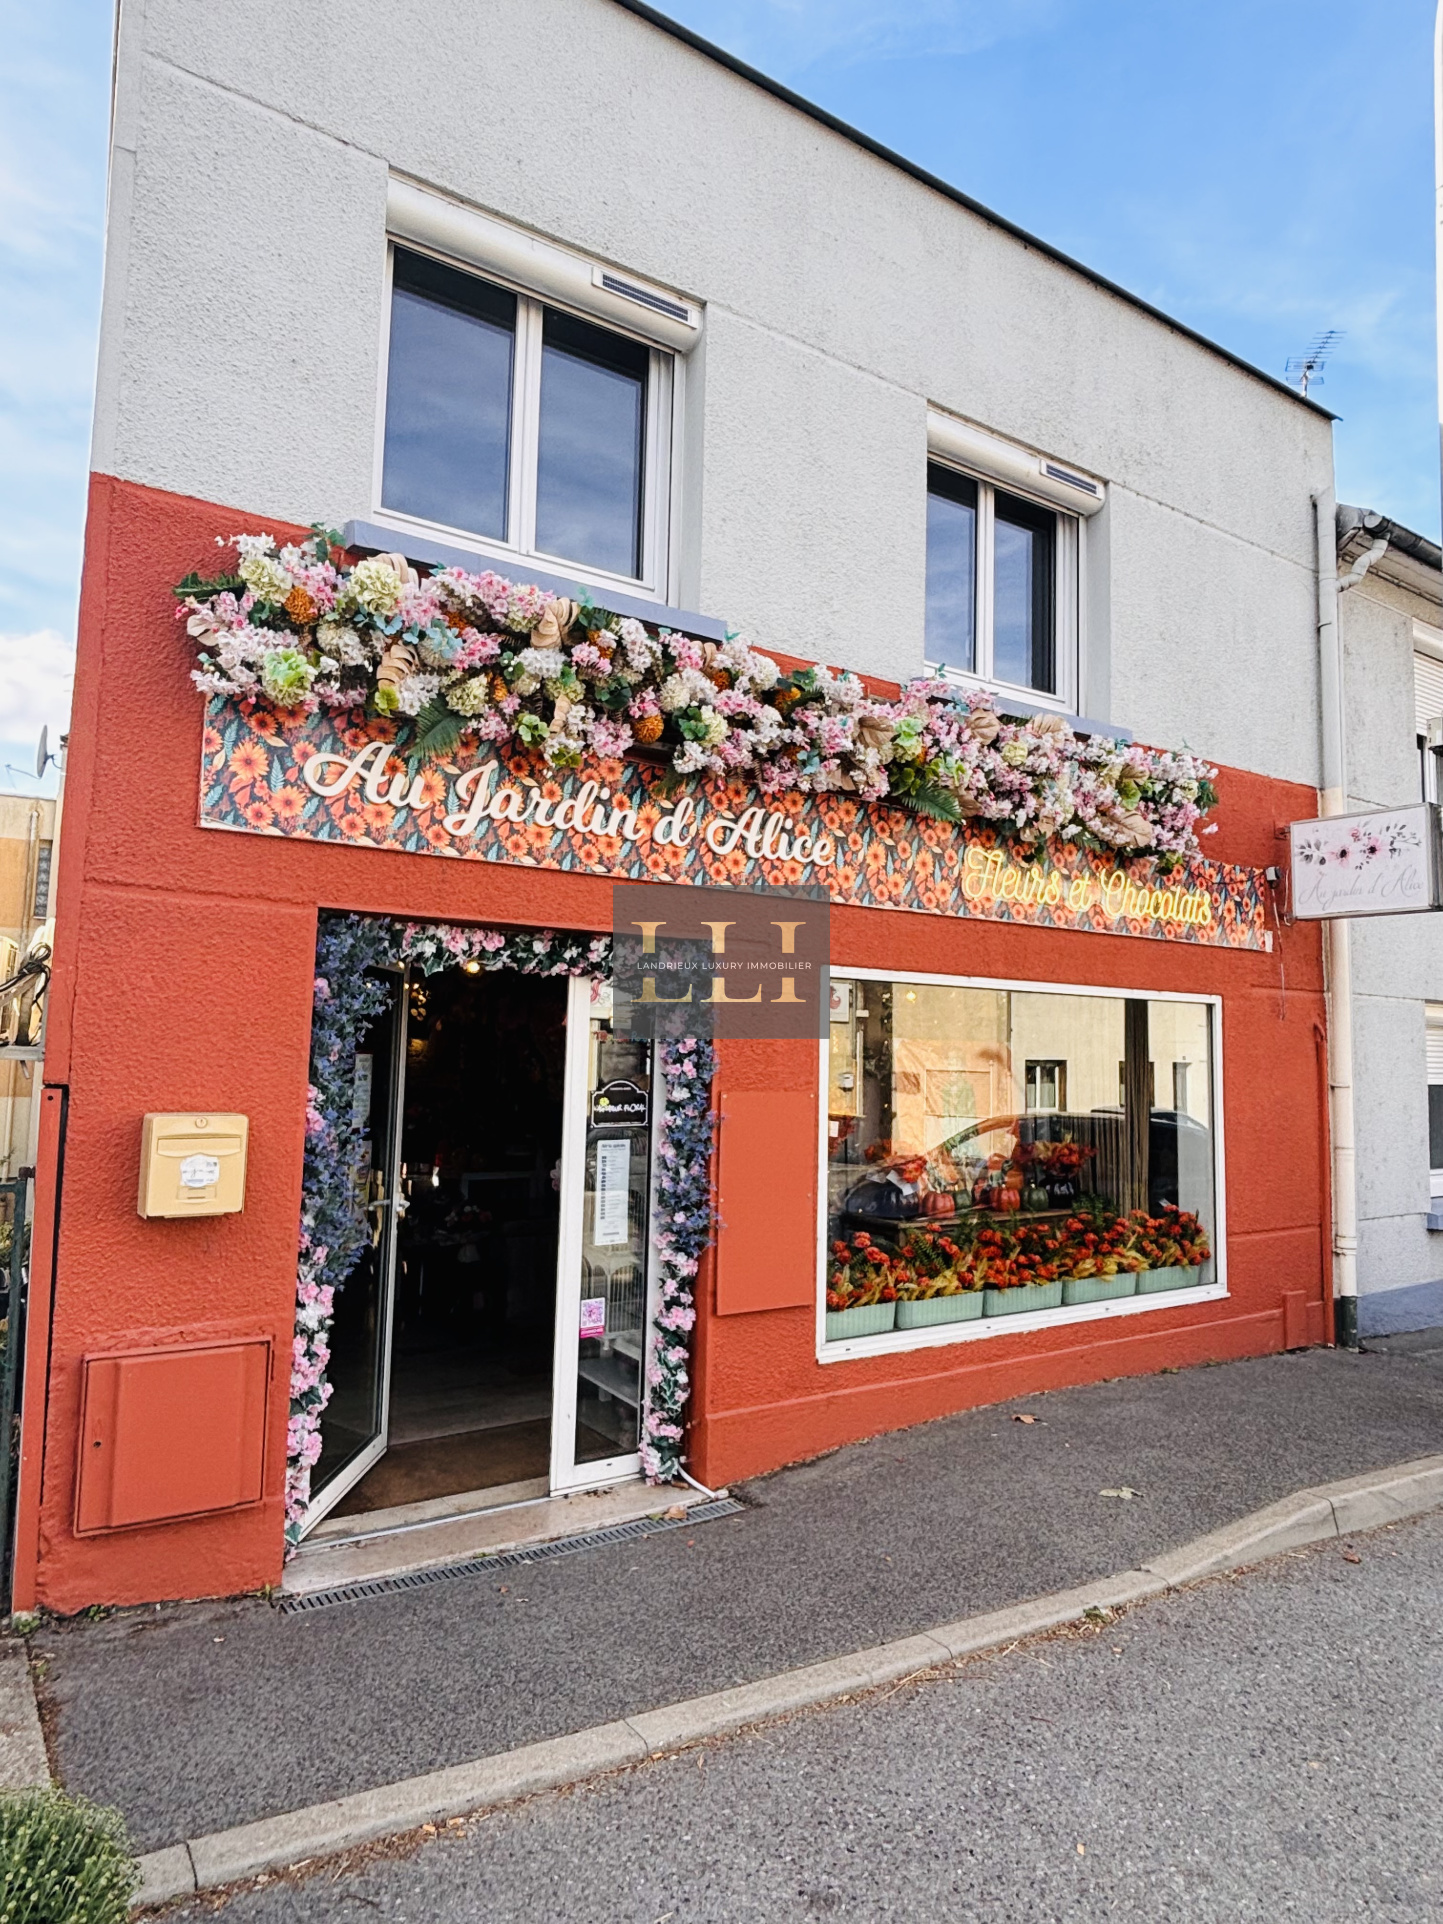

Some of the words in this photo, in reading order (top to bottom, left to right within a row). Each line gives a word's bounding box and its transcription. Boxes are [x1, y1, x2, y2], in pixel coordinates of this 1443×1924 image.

[303, 741, 427, 808] Au
[443, 759, 642, 841] Jardin
[706, 804, 834, 867] Alice
[965, 848, 1062, 906] Fleurs
[1068, 875, 1093, 911] et
[1100, 868, 1212, 926] Chocolats
